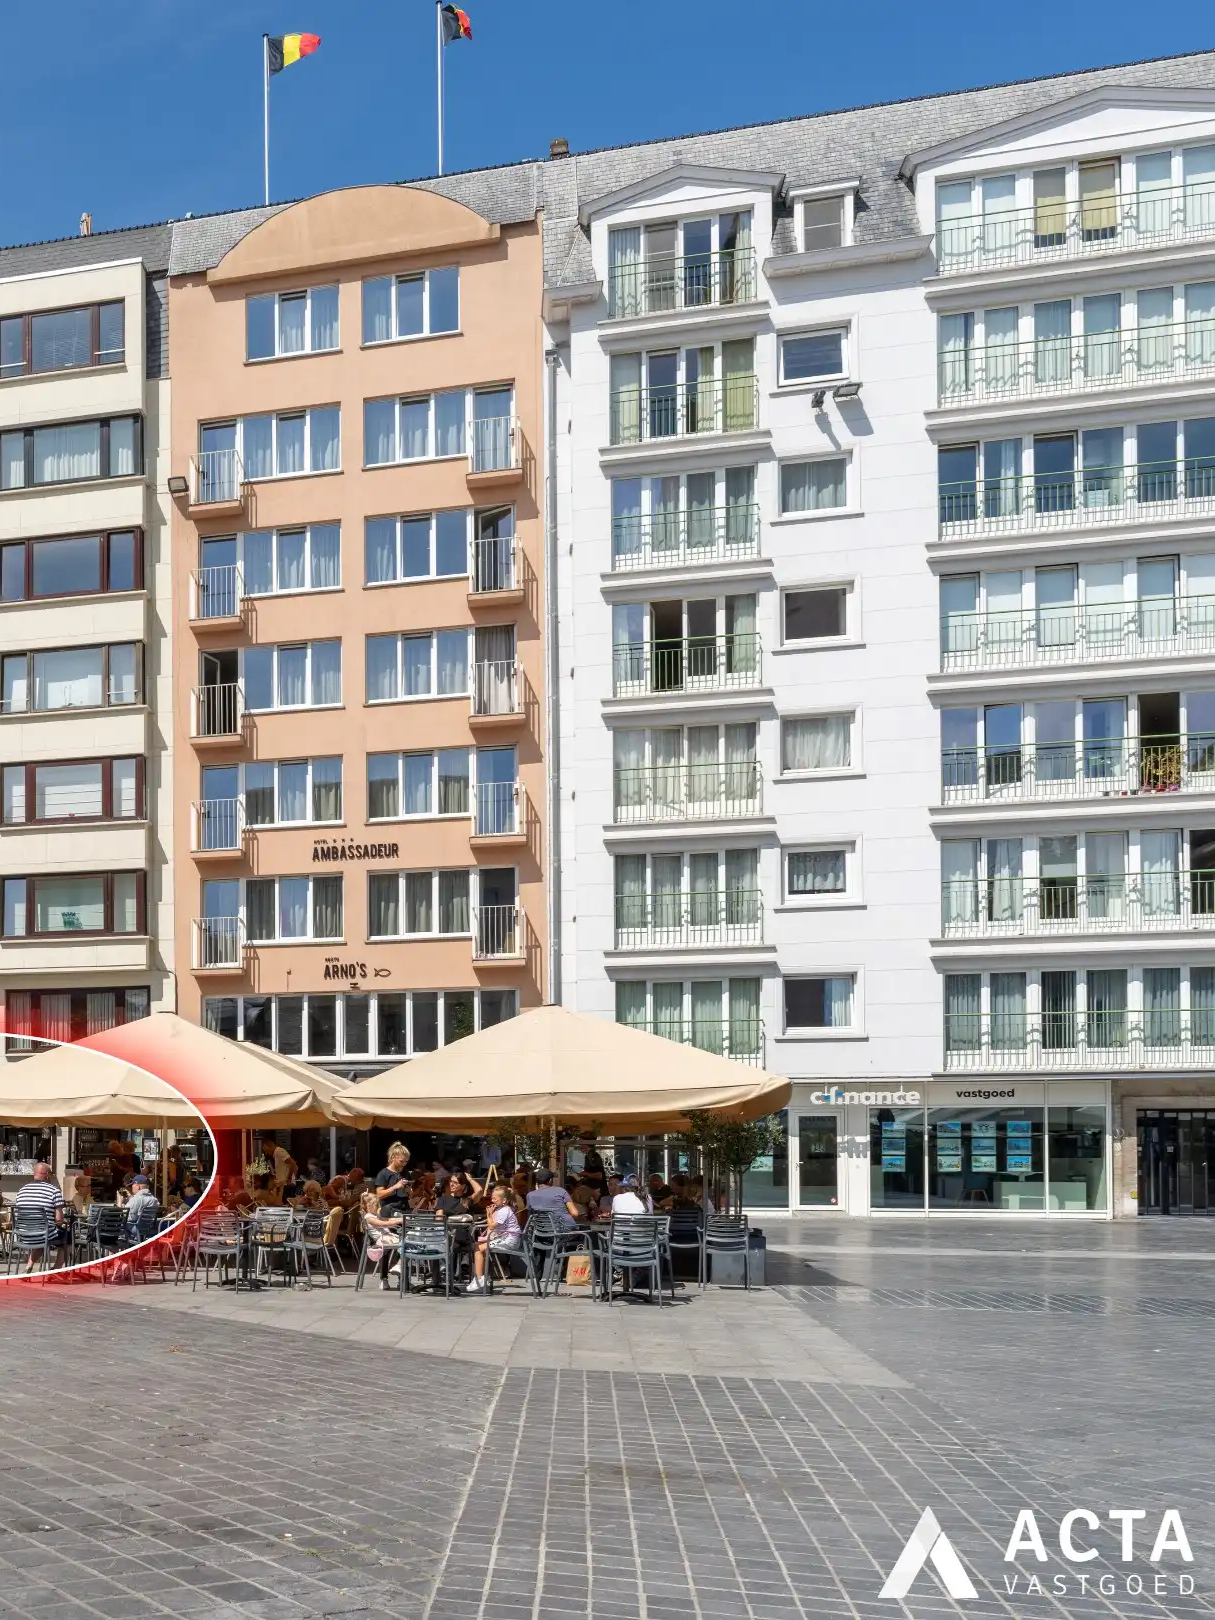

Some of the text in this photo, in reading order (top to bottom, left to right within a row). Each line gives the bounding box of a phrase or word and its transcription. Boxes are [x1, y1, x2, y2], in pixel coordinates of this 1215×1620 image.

[312, 843, 399, 862] AMBASSADEUR
[324, 961, 367, 980] ARNO'S
[956, 1088, 1015, 1099] vastgoed
